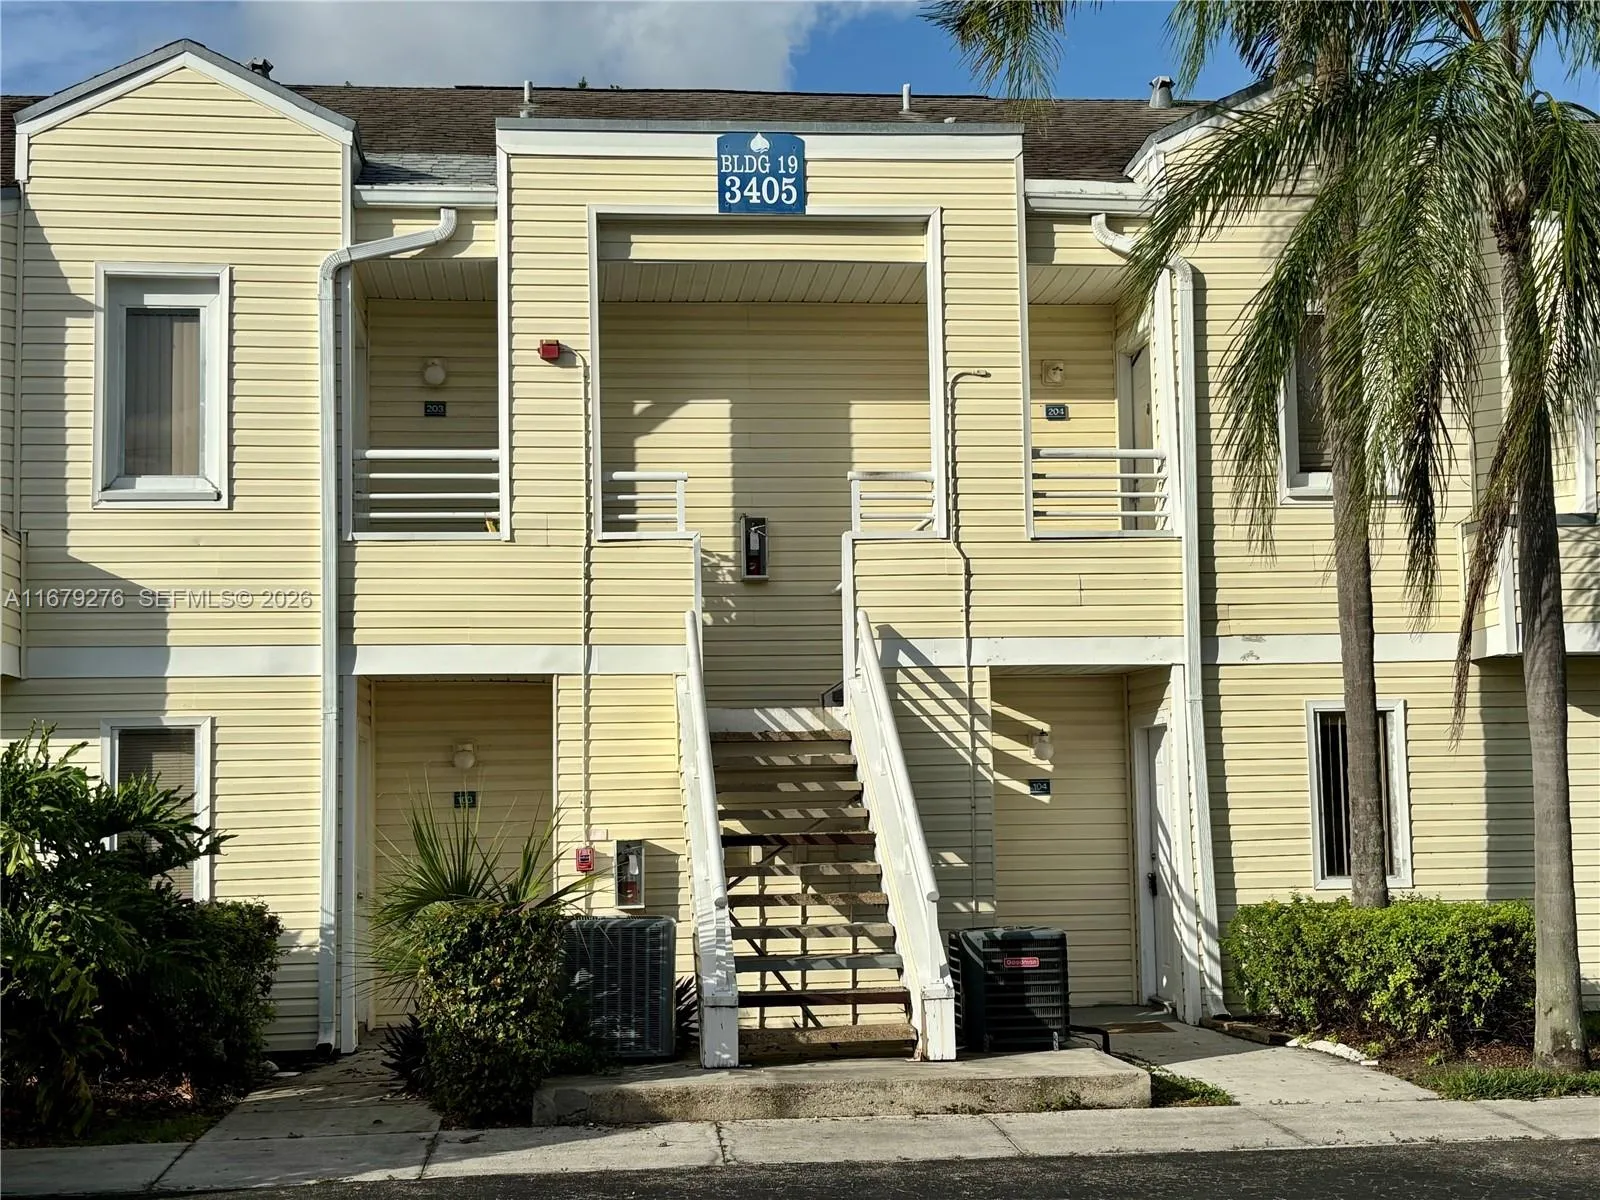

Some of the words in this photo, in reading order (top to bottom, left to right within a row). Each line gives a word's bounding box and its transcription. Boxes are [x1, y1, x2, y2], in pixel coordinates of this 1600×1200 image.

[720, 154, 771, 174] BLDG
[778, 155, 798, 174] 19
[724, 175, 798, 205] 3405
[426, 404, 445, 413] 203
[1047, 407, 1065, 416] 204
[1032, 783, 1048, 791] 104
